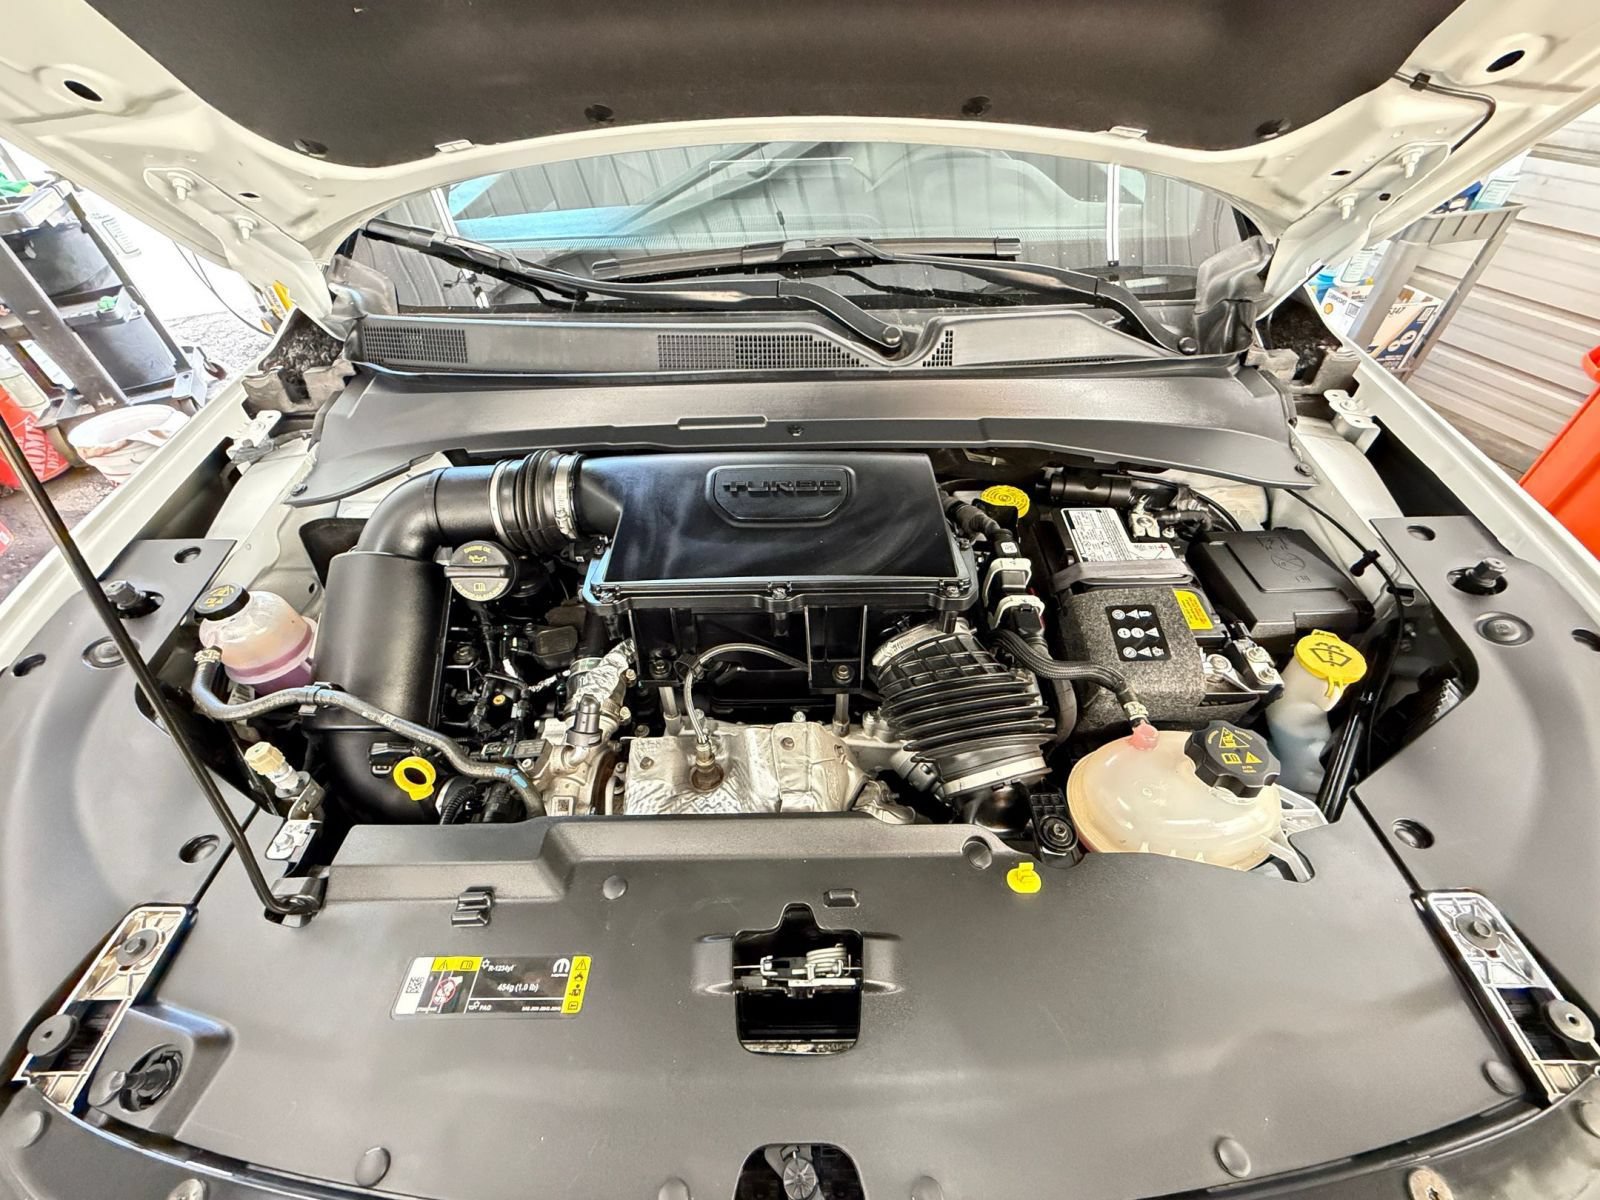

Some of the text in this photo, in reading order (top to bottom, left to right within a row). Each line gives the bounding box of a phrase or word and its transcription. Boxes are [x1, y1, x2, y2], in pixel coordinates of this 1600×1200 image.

[722, 480, 842, 493] TURBO
[497, 983, 539, 993] 454g (1.0 lb)
